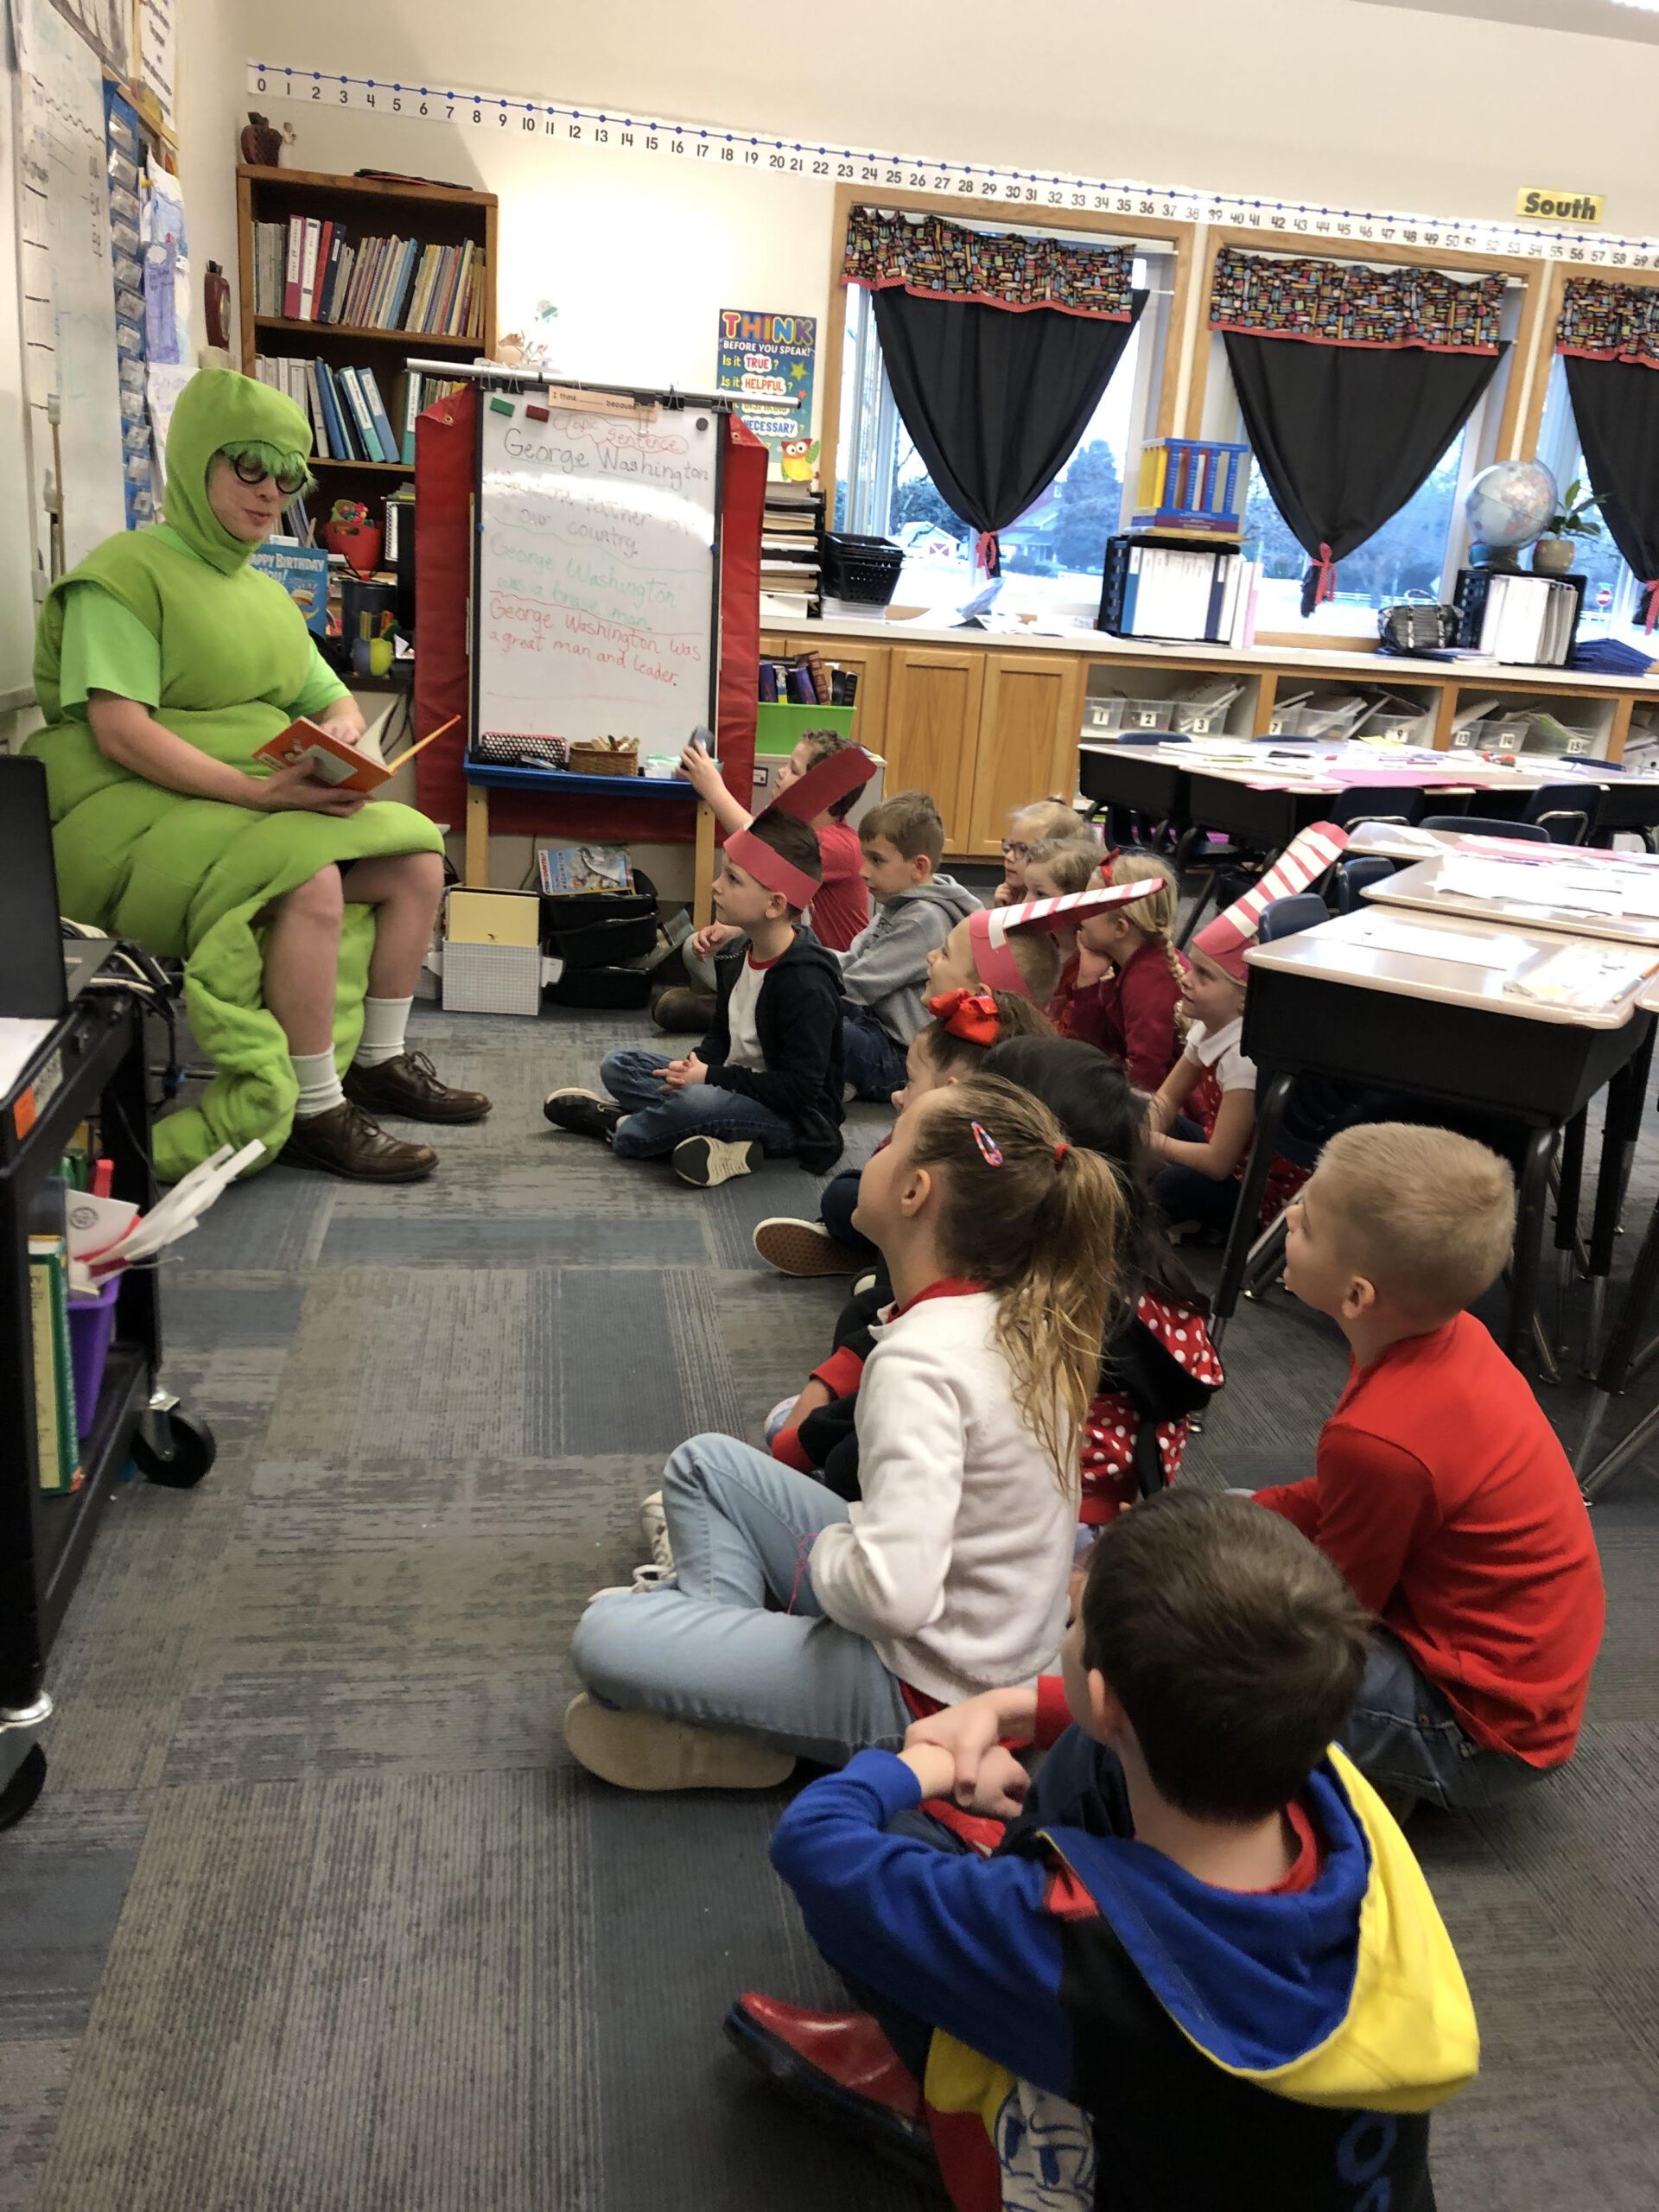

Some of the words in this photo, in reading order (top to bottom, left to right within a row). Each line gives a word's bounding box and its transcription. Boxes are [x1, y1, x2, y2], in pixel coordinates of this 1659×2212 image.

[257, 78, 266, 92] 0
[287, 82, 290, 95] 1
[312, 86, 321, 99] 2
[340, 90, 348, 104] 3
[366, 94, 375, 107] 4
[393, 98, 401, 111] 5
[419, 102, 428, 115] 6
[446, 105, 454, 119] 7
[473, 110, 481, 124] 8
[499, 113, 507, 127] 9
[523, 118, 535, 131] 10
[546, 121, 554, 135] 11
[569, 124, 581, 139] 12
[595, 129, 608, 143] 13
[621, 133, 633, 146] 14
[646, 137, 658, 150] 15
[671, 140, 683, 154] 16
[696, 144, 709, 157] 17
[721, 148, 734, 162] 18
[746, 151, 759, 164] 19
[769, 155, 785, 168] 20
[790, 158, 803, 171] 21
[812, 161, 829, 175] 22
[837, 163, 854, 177] 23
[861, 167, 878, 181] 24
[886, 170, 902, 184] 25
[909, 173, 926, 187] 26
[934, 176, 950, 189] 27
[958, 179, 974, 193] 28
[982, 182, 997, 194] 29
[1006, 185, 1020, 199] 30
[1026, 188, 1037, 201] 31
[1047, 191, 1063, 204] 32
[1071, 194, 1085, 207] 33
[1094, 196, 1109, 209] 34
[1116, 199, 1131, 212] 35
[1139, 201, 1154, 214] 36
[1162, 204, 1177, 217] 37
[1185, 207, 1198, 220] 38
[1208, 209, 1223, 220] 39
[1230, 213, 1244, 225] 40
[1249, 213, 1260, 226] 41
[1271, 216, 1286, 229] 42
[1294, 219, 1307, 231] 43
[1316, 221, 1330, 232] 44
[1338, 223, 1351, 235] 45
[1359, 226, 1372, 238] 46
[1382, 228, 1395, 239] 47
[1403, 230, 1417, 243] 48
[1424, 232, 1439, 245] 49
[1446, 234, 1459, 247] 50
[1507, 242, 1520, 254] 53
[1528, 245, 1541, 256] 54
[1550, 245, 1564, 257] 55
[1570, 248, 1584, 260] 56
[1591, 251, 1605, 262] 57
[1611, 252, 1627, 264] 58
[1632, 255, 1649, 267] 59
[1523, 192, 1596, 220] South
[722, 312, 813, 346] THINK
[723, 340, 756, 353] BEFORE
[759, 344, 778, 353] YOU
[779, 346, 810, 356] SPEAK!
[722, 355, 732, 366] Is
[734, 356, 741, 366] it
[747, 357, 769, 370] TRUE
[721, 376, 730, 387] Is
[733, 377, 740, 387] it
[745, 378, 783, 391] HELPFUL
[744, 420, 795, 433] NECESSARY
[504, 428, 589, 474] George
[595, 442, 710, 490] Washington
[491, 537, 554, 575] George
[568, 556, 677, 608] Washington
[490, 600, 554, 632] George
[566, 613, 660, 655] Washington
[501, 631, 546, 652] great
[553, 640, 591, 659] man
[597, 649, 626, 669] and
[1098, 711, 1104, 721] 1
[1145, 714, 1153, 725] 2
[1197, 719, 1205, 730] 3
[1271, 722, 1279, 734] 7
[1397, 730, 1403, 740] 9
[1459, 733, 1468, 744] 13
[1503, 734, 1513, 746] 14
[1571, 740, 1582, 751] 15
